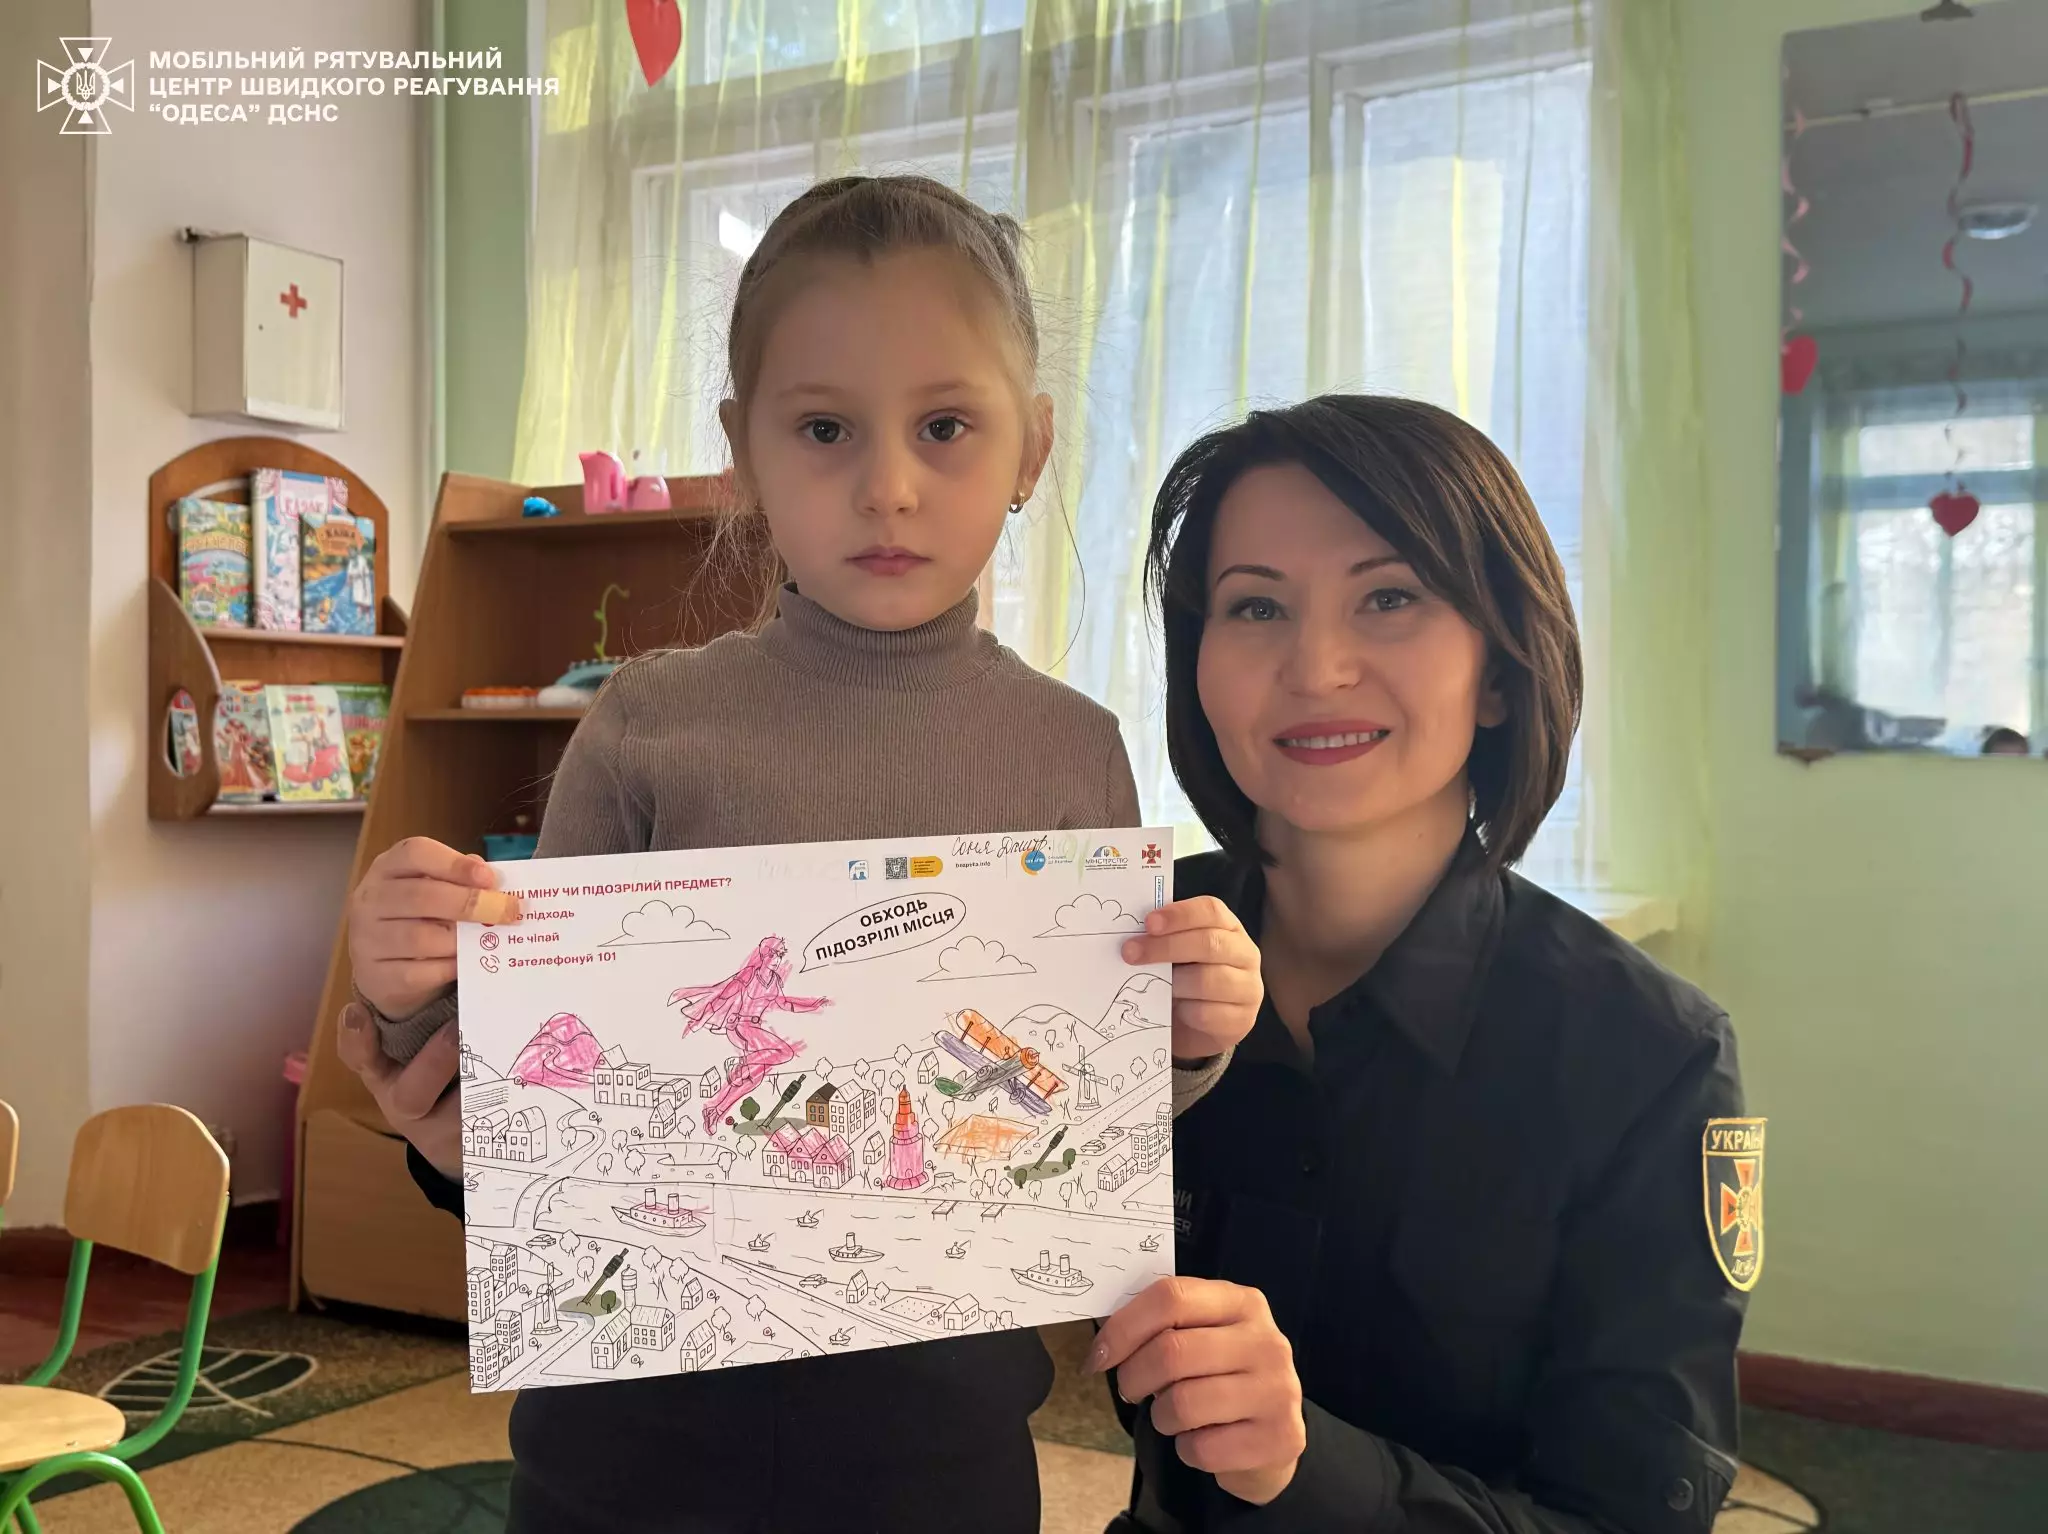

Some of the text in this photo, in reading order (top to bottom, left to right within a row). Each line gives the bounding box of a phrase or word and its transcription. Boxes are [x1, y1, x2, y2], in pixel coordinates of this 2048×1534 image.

[528, 888, 560, 899] МІНУ
[562, 886, 579, 897] ЧИ
[583, 880, 662, 896] ПІДОЗРІЛИЙ
[665, 877, 732, 891] ПРЕДМЕТ?
[526, 910, 575, 922] підходь
[860, 899, 928, 928] ОБХОДЬ
[508, 932, 560, 944] Не чіпай
[815, 907, 955, 960] ПІДОЗРІЛІ МІСЦЯ
[508, 951, 617, 967] Зателефонуй 101
